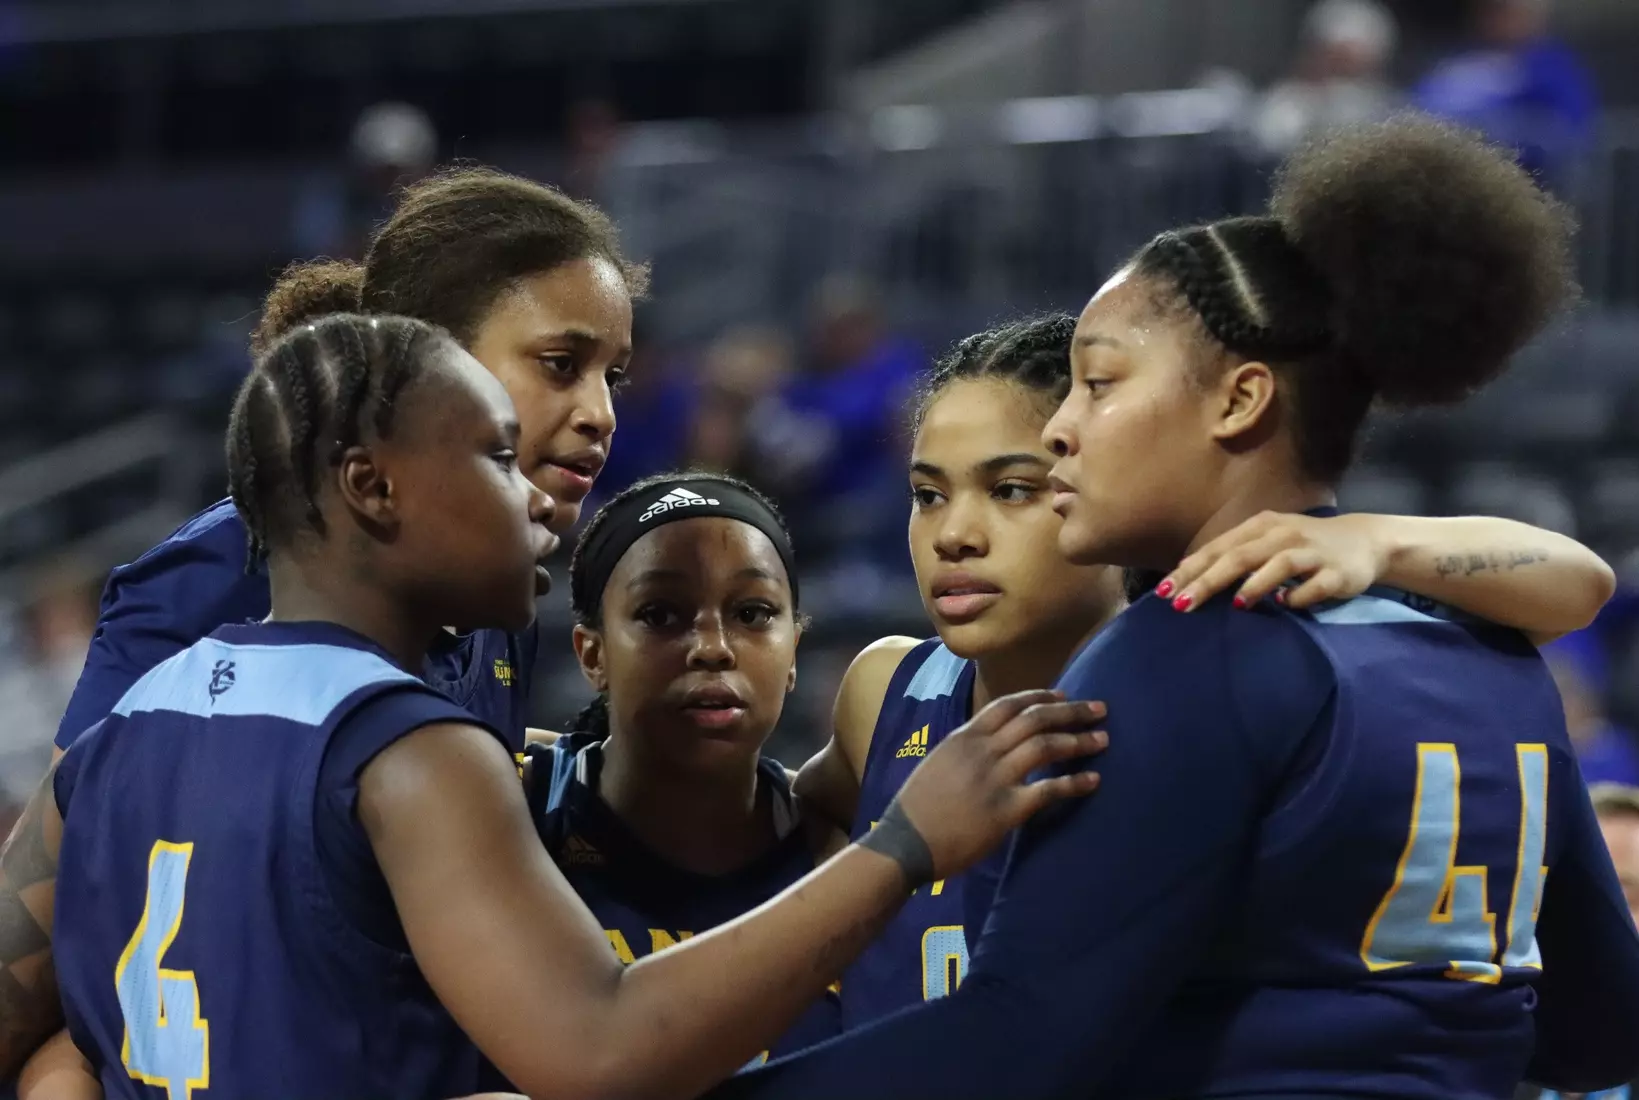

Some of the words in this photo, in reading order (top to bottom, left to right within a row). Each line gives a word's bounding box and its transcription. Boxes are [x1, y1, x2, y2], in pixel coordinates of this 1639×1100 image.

[639, 498, 720, 522] adidas
[896, 744, 927, 759] adida
[115, 838, 210, 1100] 4
